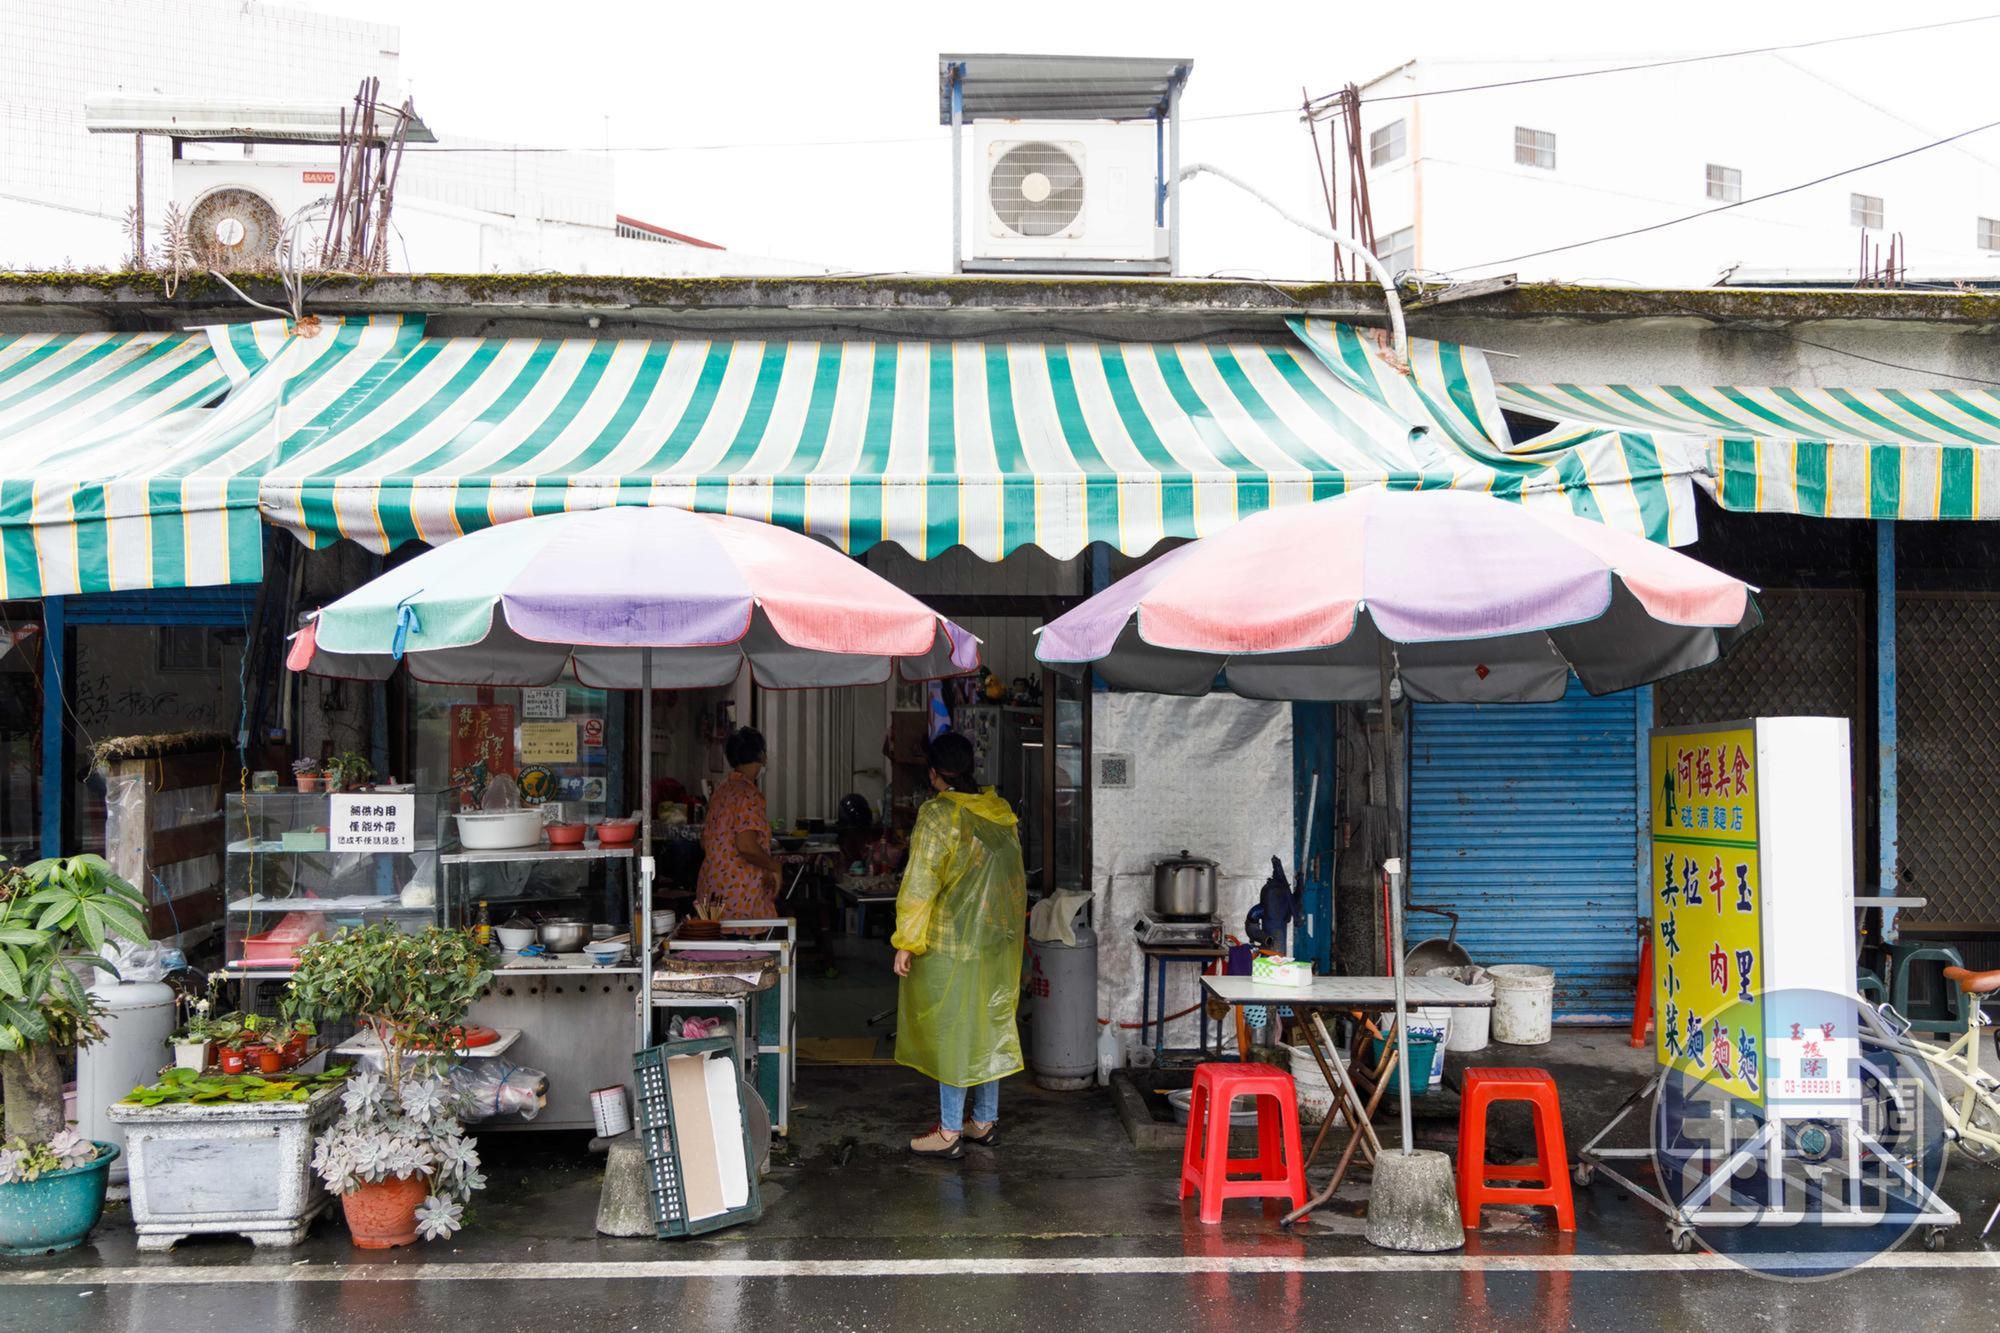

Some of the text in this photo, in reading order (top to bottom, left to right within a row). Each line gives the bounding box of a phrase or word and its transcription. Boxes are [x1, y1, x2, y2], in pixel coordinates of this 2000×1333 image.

[303, 173, 334, 182] SANYO
[1677, 744, 1751, 799] 阿梅美食
[1660, 852, 1683, 1058] 美味小菜
[1682, 856, 1706, 1068] 拉麵
[1708, 855, 1732, 1080] 牛肉麵
[1735, 864, 1760, 1092] 玉里麵
